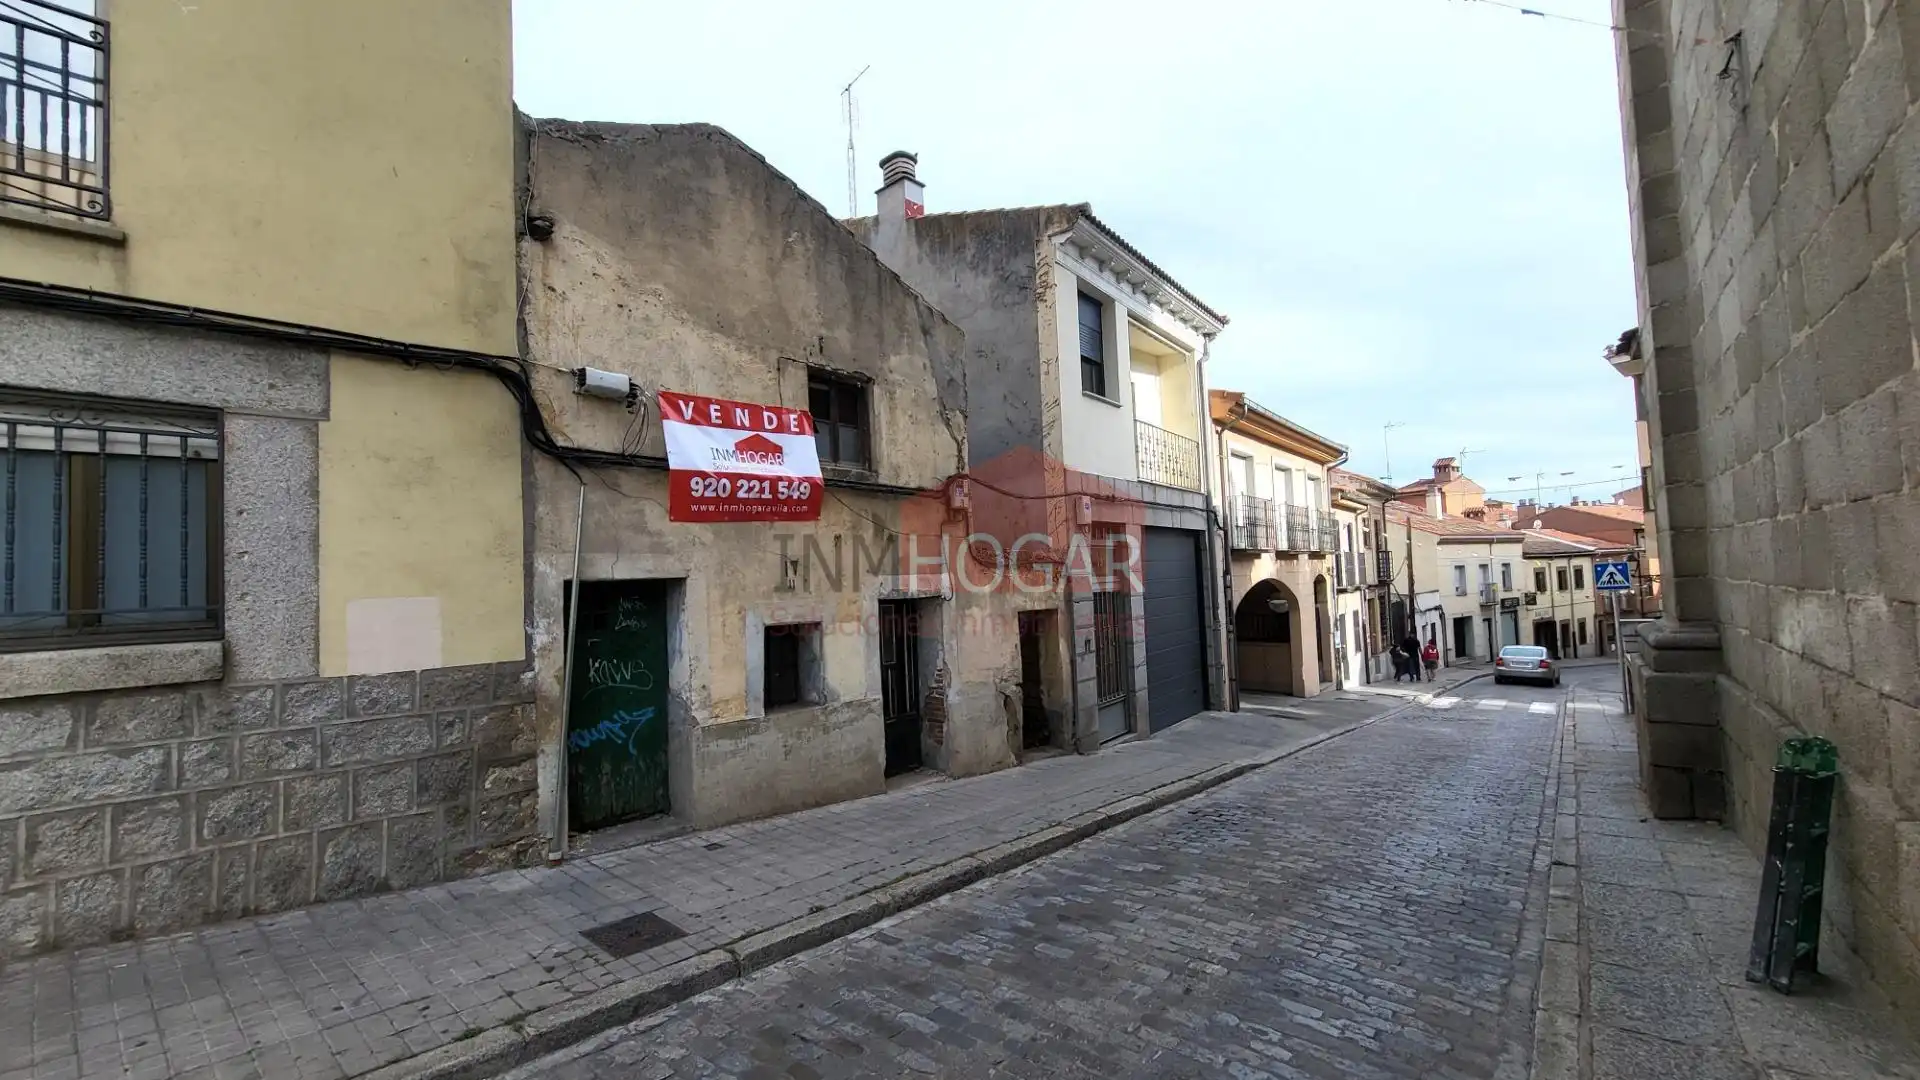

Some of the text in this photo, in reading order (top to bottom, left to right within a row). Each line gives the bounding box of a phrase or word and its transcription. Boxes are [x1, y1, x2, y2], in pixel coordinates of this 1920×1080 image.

[678, 399, 801, 432] VENDE
[710, 446, 784, 466] INMHOGAR
[690, 476, 811, 500] 920 221 549
[690, 502, 808, 514] www.inmhogaravila.com
